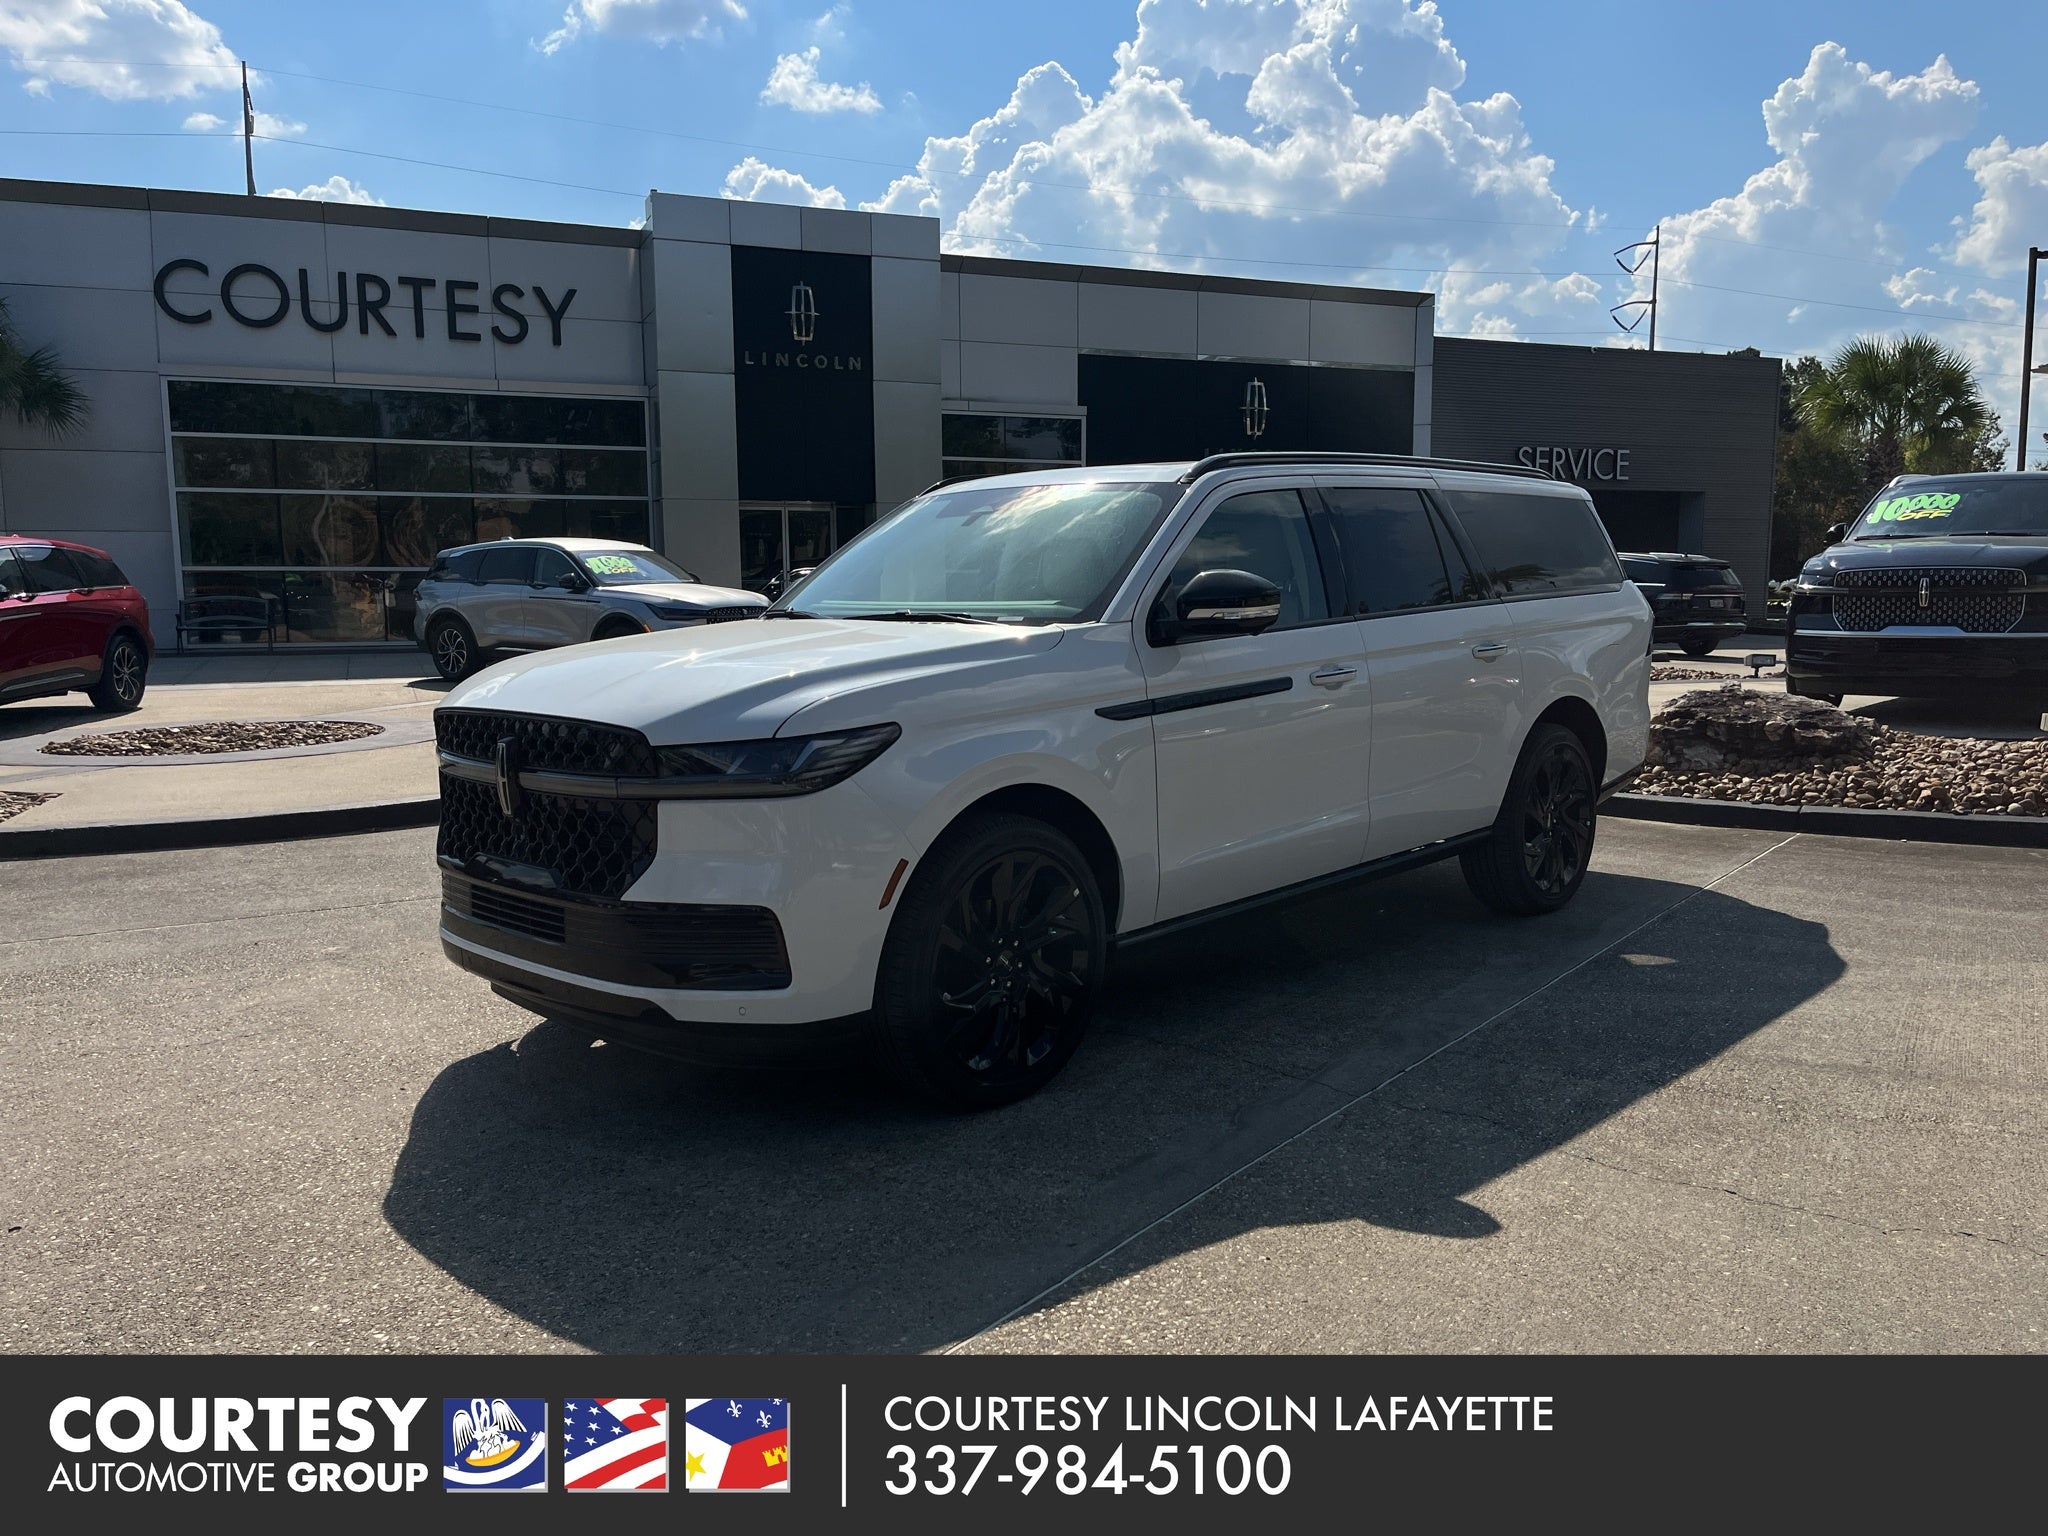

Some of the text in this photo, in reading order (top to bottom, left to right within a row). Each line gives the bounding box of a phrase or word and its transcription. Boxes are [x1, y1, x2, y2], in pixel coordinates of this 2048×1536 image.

[153, 258, 578, 347] COURTESY
[744, 350, 863, 371] LINCOLN
[1518, 446, 1630, 480] SERVICE
[1896, 509, 1953, 521] OFF
